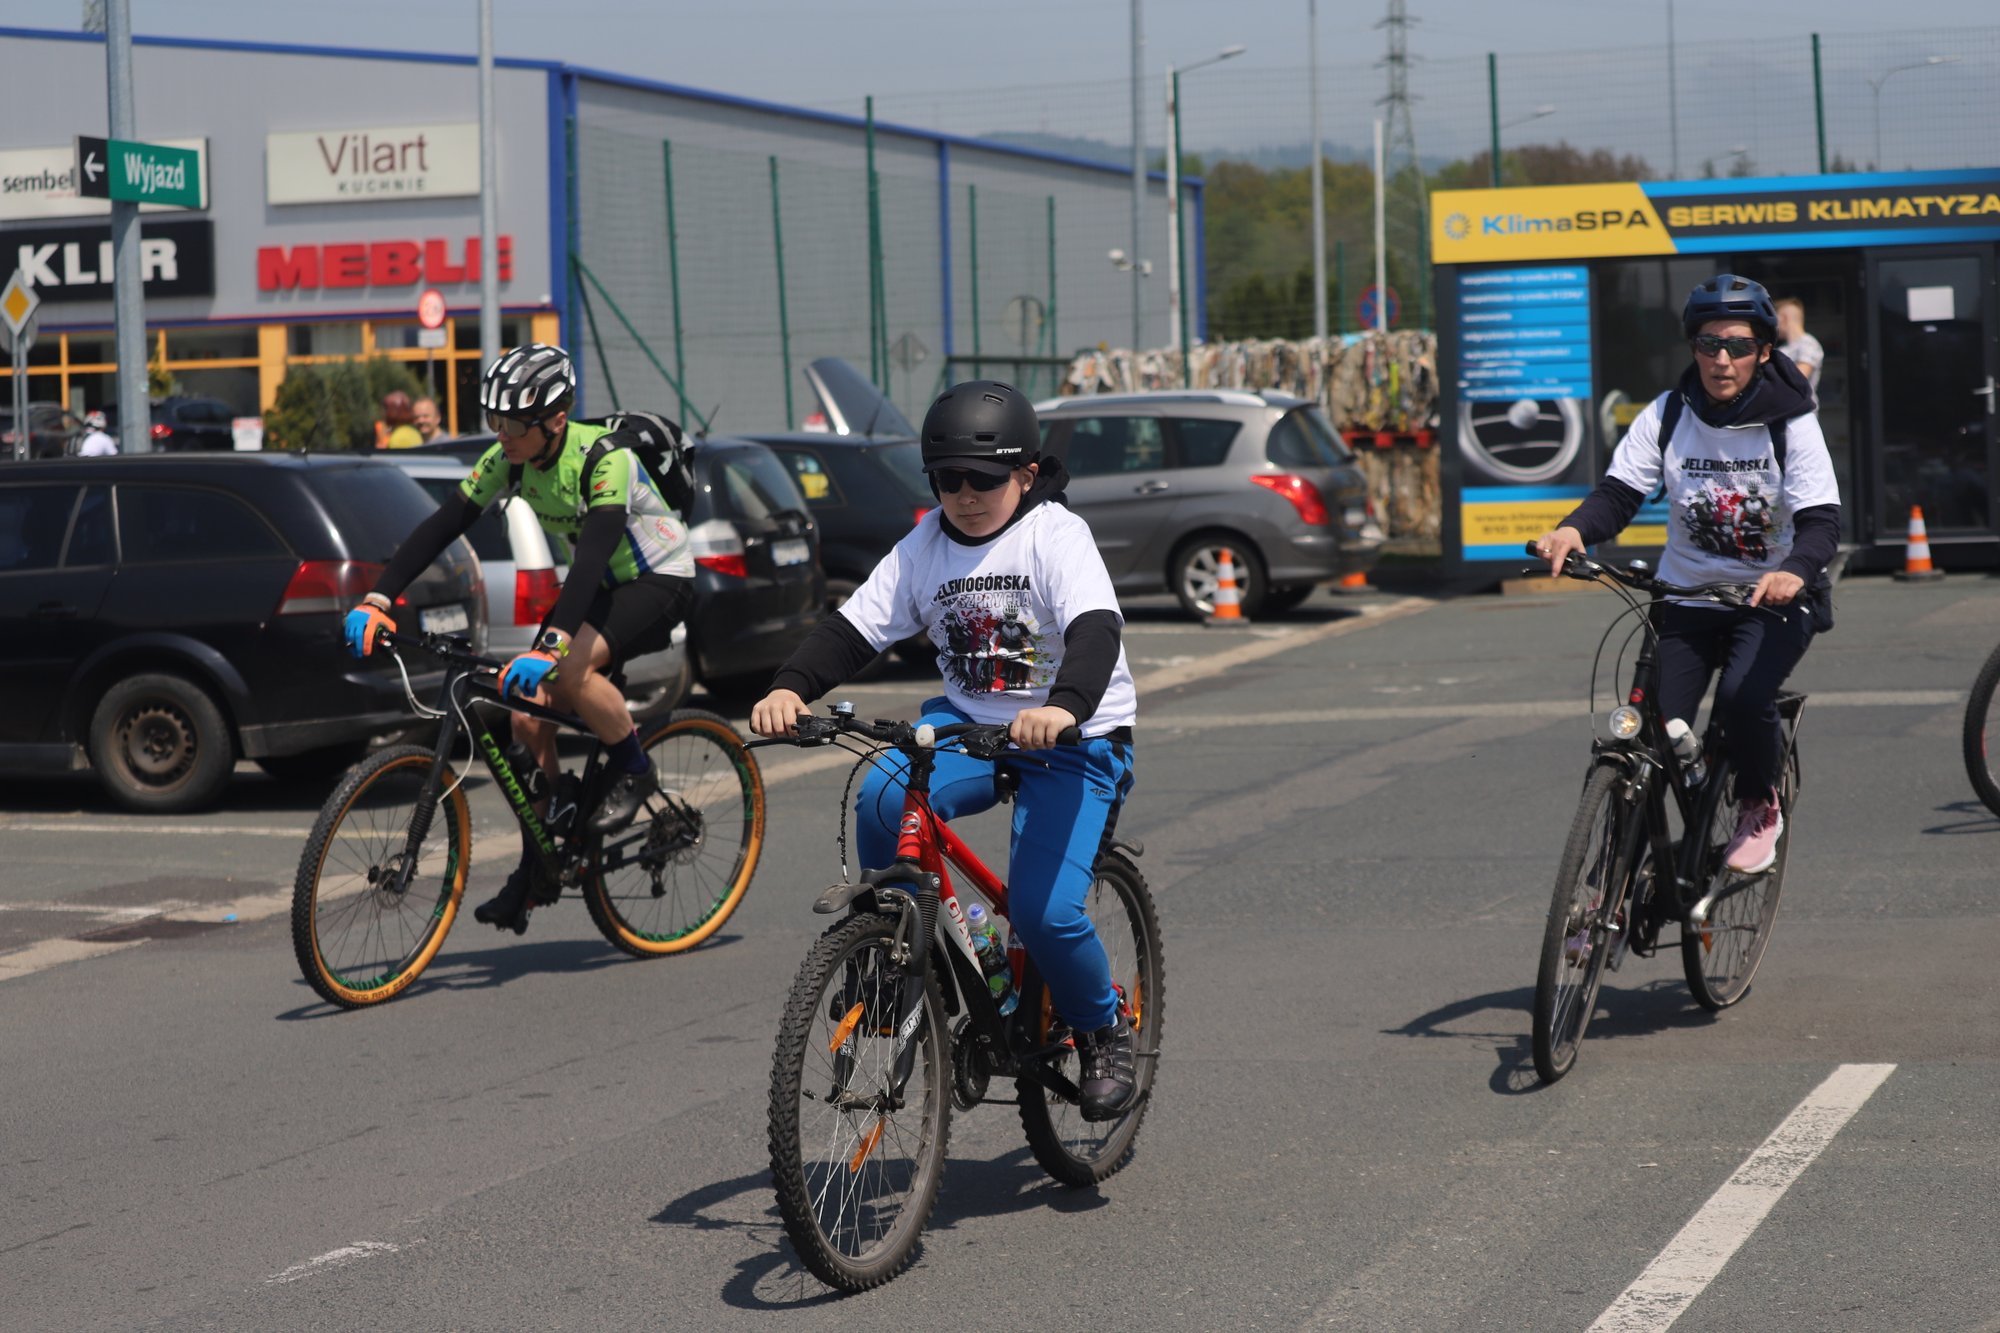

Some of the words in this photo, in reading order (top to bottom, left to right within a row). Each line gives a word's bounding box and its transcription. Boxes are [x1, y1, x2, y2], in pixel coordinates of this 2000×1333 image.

[317, 133, 429, 176] Vilart
[3, 168, 75, 193] sembel
[124, 152, 185, 194] Wyjazd
[338, 178, 426, 193] KUCHNIE
[1481, 209, 1650, 235] KlimaSPA
[1667, 202, 1798, 227] SERWIS
[1808, 194, 2000, 221] KLIMATYZA
[257, 234, 513, 290] MEBLE
[1681, 457, 1770, 473] JELENIOGÓRSKA
[960, 591, 1032, 609] SZPRYCHA
